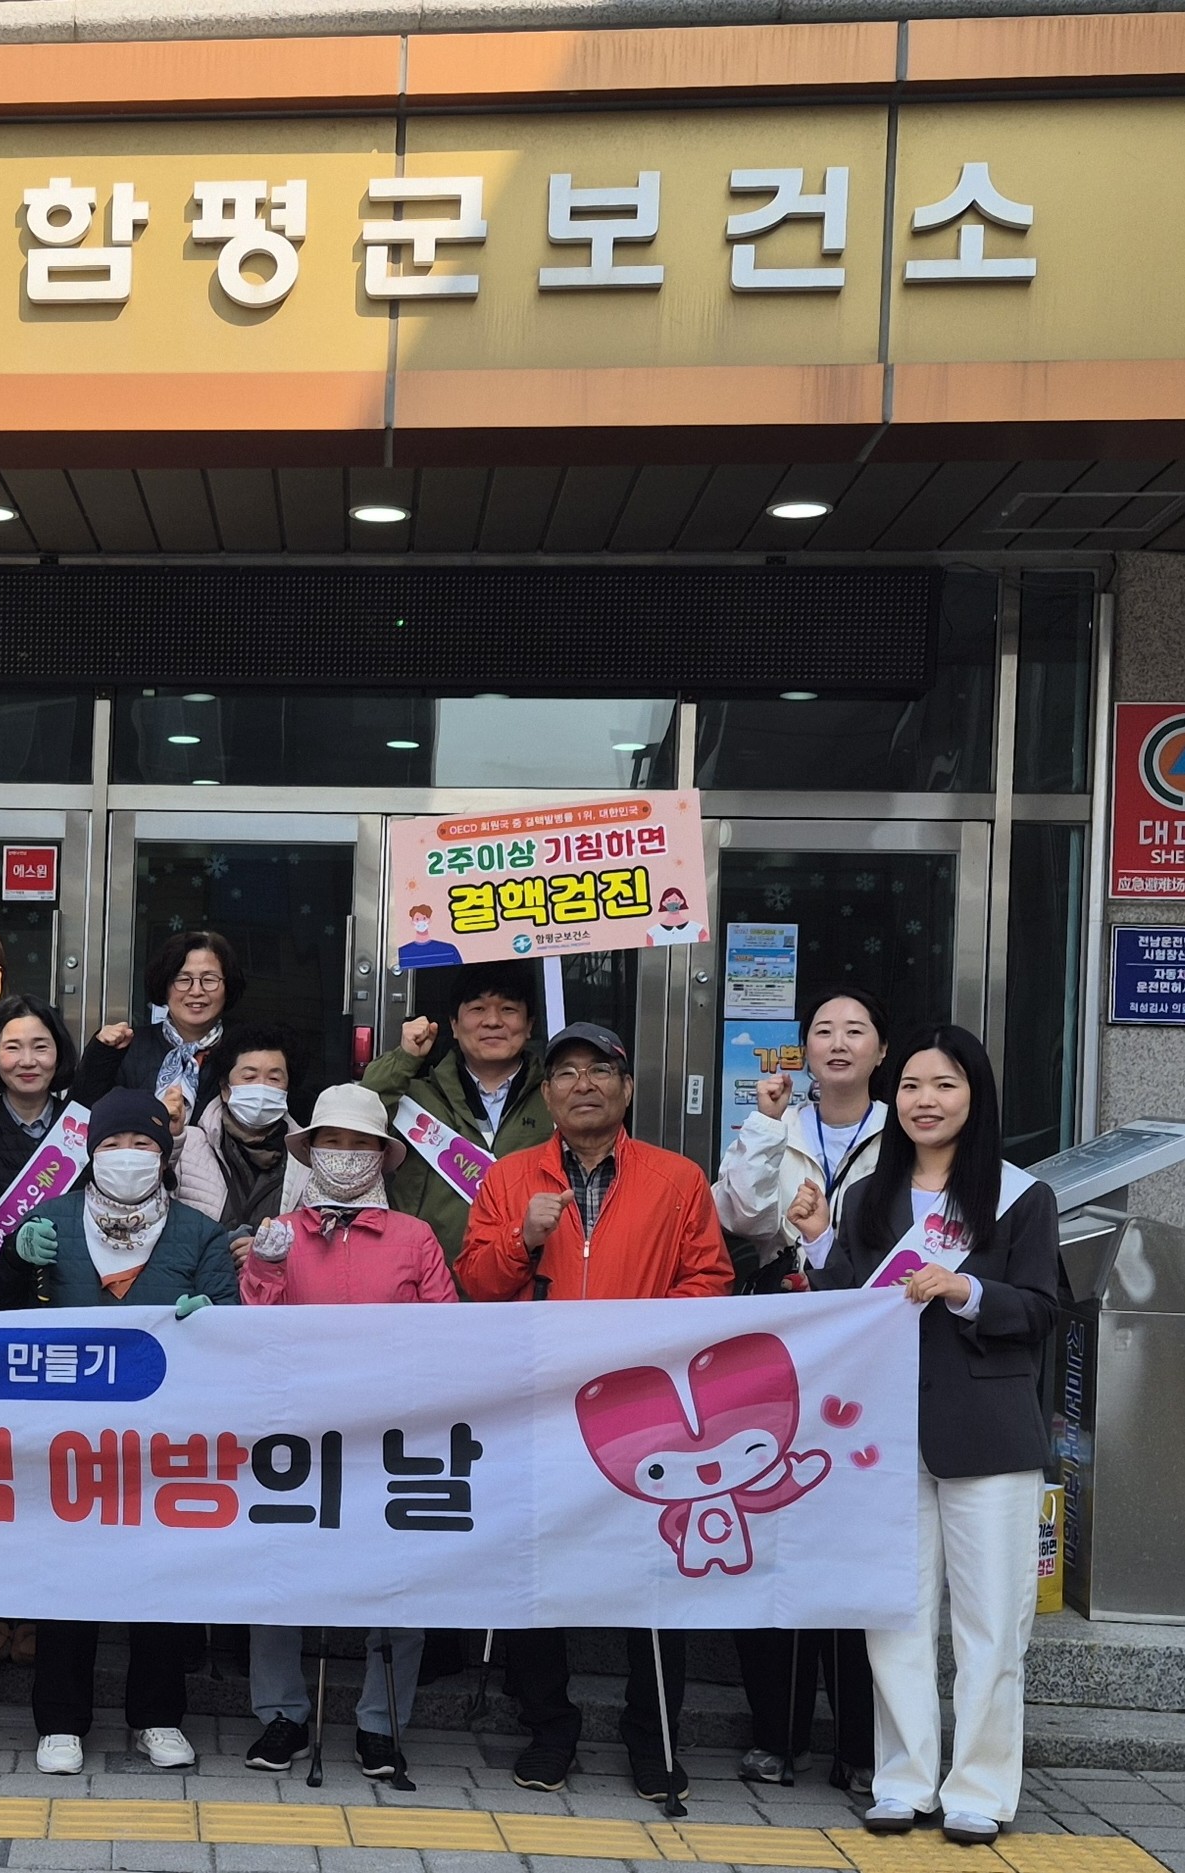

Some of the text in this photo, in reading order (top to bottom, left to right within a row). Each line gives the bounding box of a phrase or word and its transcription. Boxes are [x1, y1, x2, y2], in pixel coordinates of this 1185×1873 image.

[22, 162, 1038, 309] 함평군보건소
[449, 805, 639, 835] OECD 회원국 중 결핵발병률 1위, 대한민국
[427, 825, 667, 876] 2주이상 기침하면
[13, 864, 47, 878] 에스원
[448, 866, 652, 934] 결핵검진
[536, 930, 591, 945] 함평군보건소
[1138, 935, 1185, 948] 전남운전
[1129, 1001, 1168, 1013] 적성검사
[7, 1340, 118, 1386] 만들기
[49, 1427, 343, 1531] 예방의
[382, 1421, 484, 1532] 날
[1039, 1538, 1057, 1558] 하면
